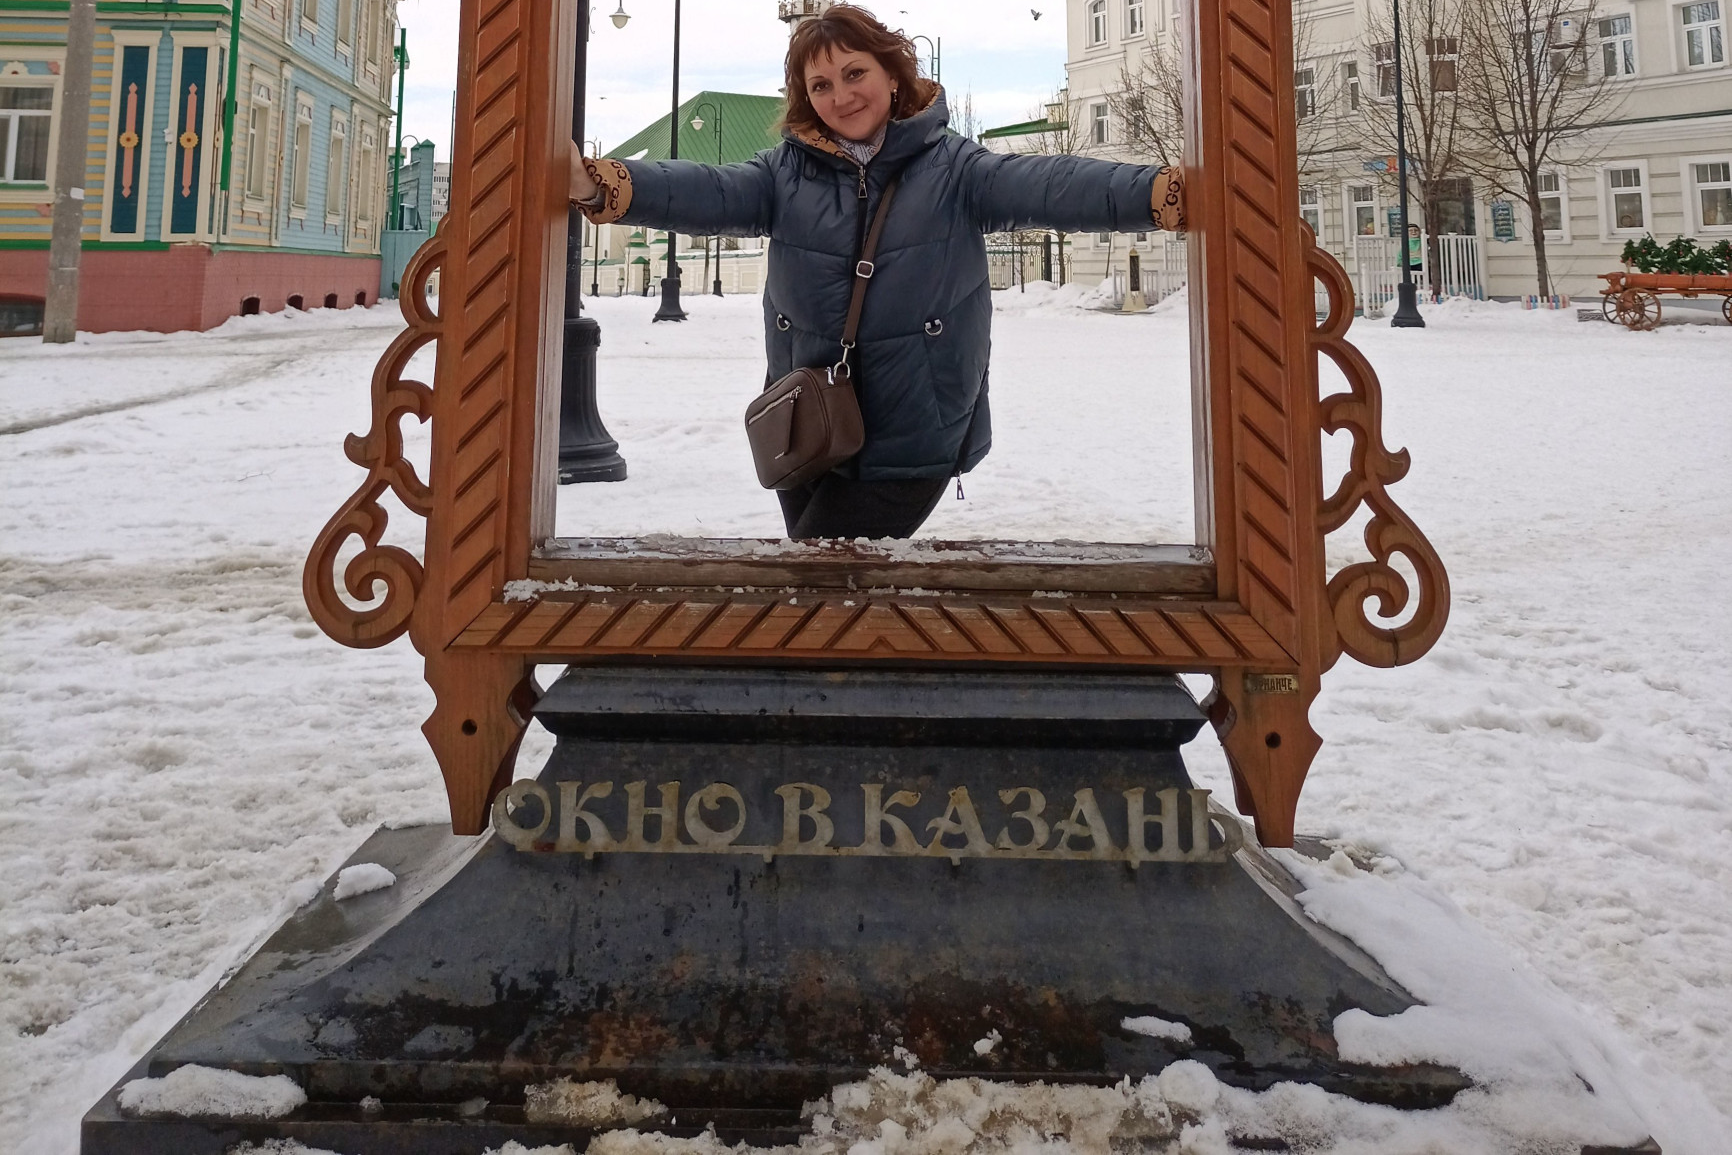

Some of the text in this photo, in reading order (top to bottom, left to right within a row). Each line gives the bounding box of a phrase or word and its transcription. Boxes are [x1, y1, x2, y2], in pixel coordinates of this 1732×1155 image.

[492, 778, 1244, 859] ОКНО В КАЗАНЬ
